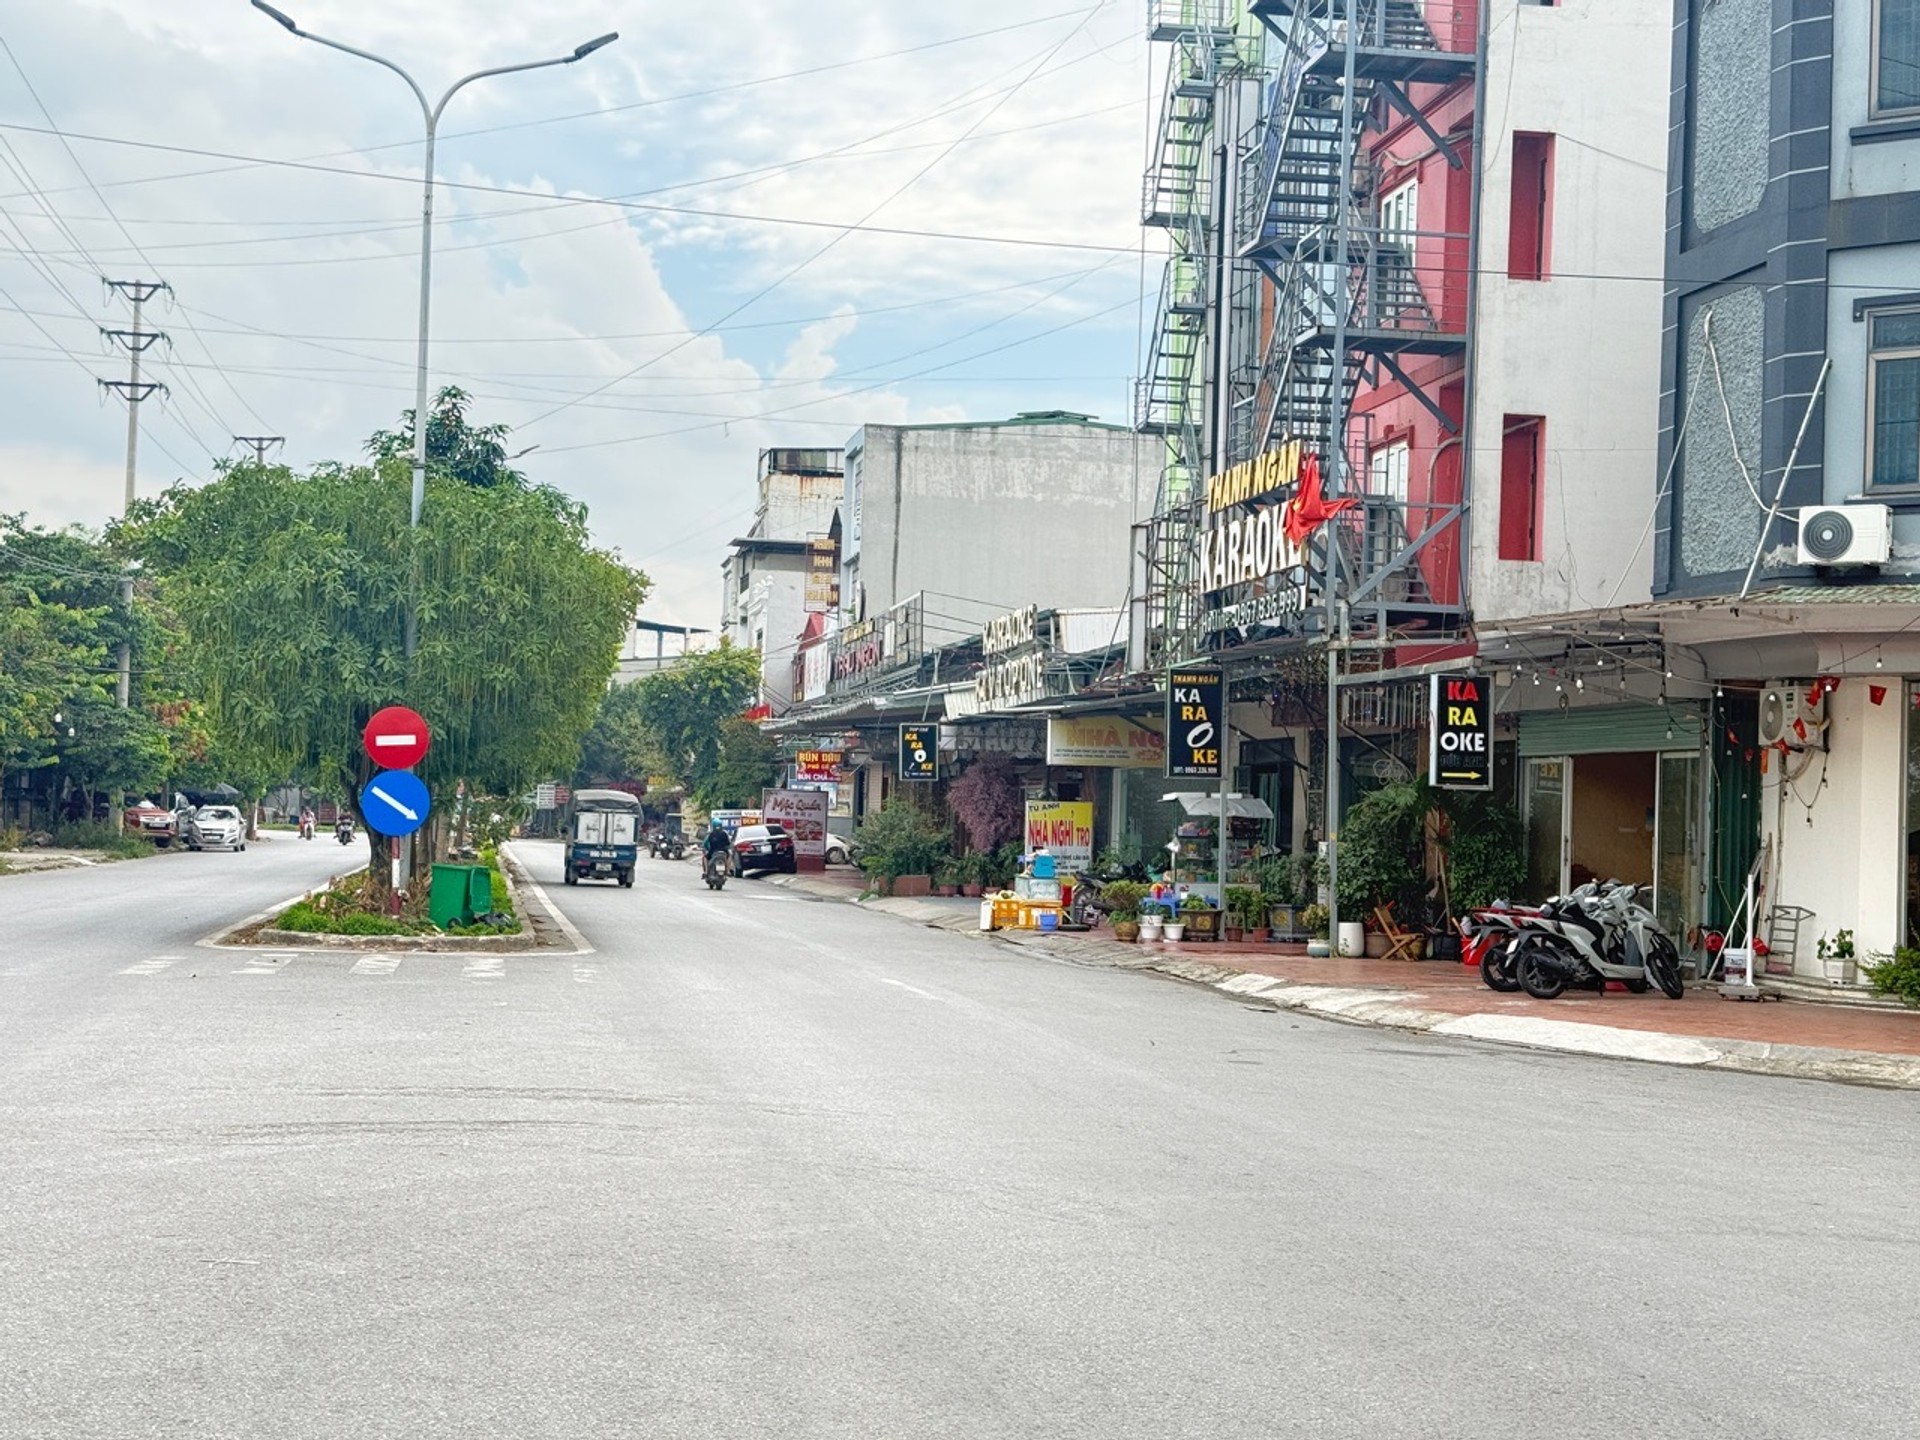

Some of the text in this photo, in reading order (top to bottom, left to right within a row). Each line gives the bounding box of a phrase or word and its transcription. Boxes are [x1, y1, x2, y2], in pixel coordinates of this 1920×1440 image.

[1207, 433, 1303, 515] THANH NGÂN
[982, 603, 1035, 656] KARAOKE
[1174, 688, 1201, 703] KA
[1447, 681, 1479, 701] KA
[1182, 706, 1208, 721] RA
[1448, 706, 1478, 726] RA
[905, 732, 918, 741] KA
[1066, 725, 1165, 748] NHÀ NG
[1187, 721, 1214, 748] O
[1440, 731, 1485, 751] OKE
[911, 741, 923, 749] RA
[914, 749, 927, 763] O
[1193, 749, 1218, 764] KE
[921, 762, 934, 771] KE
